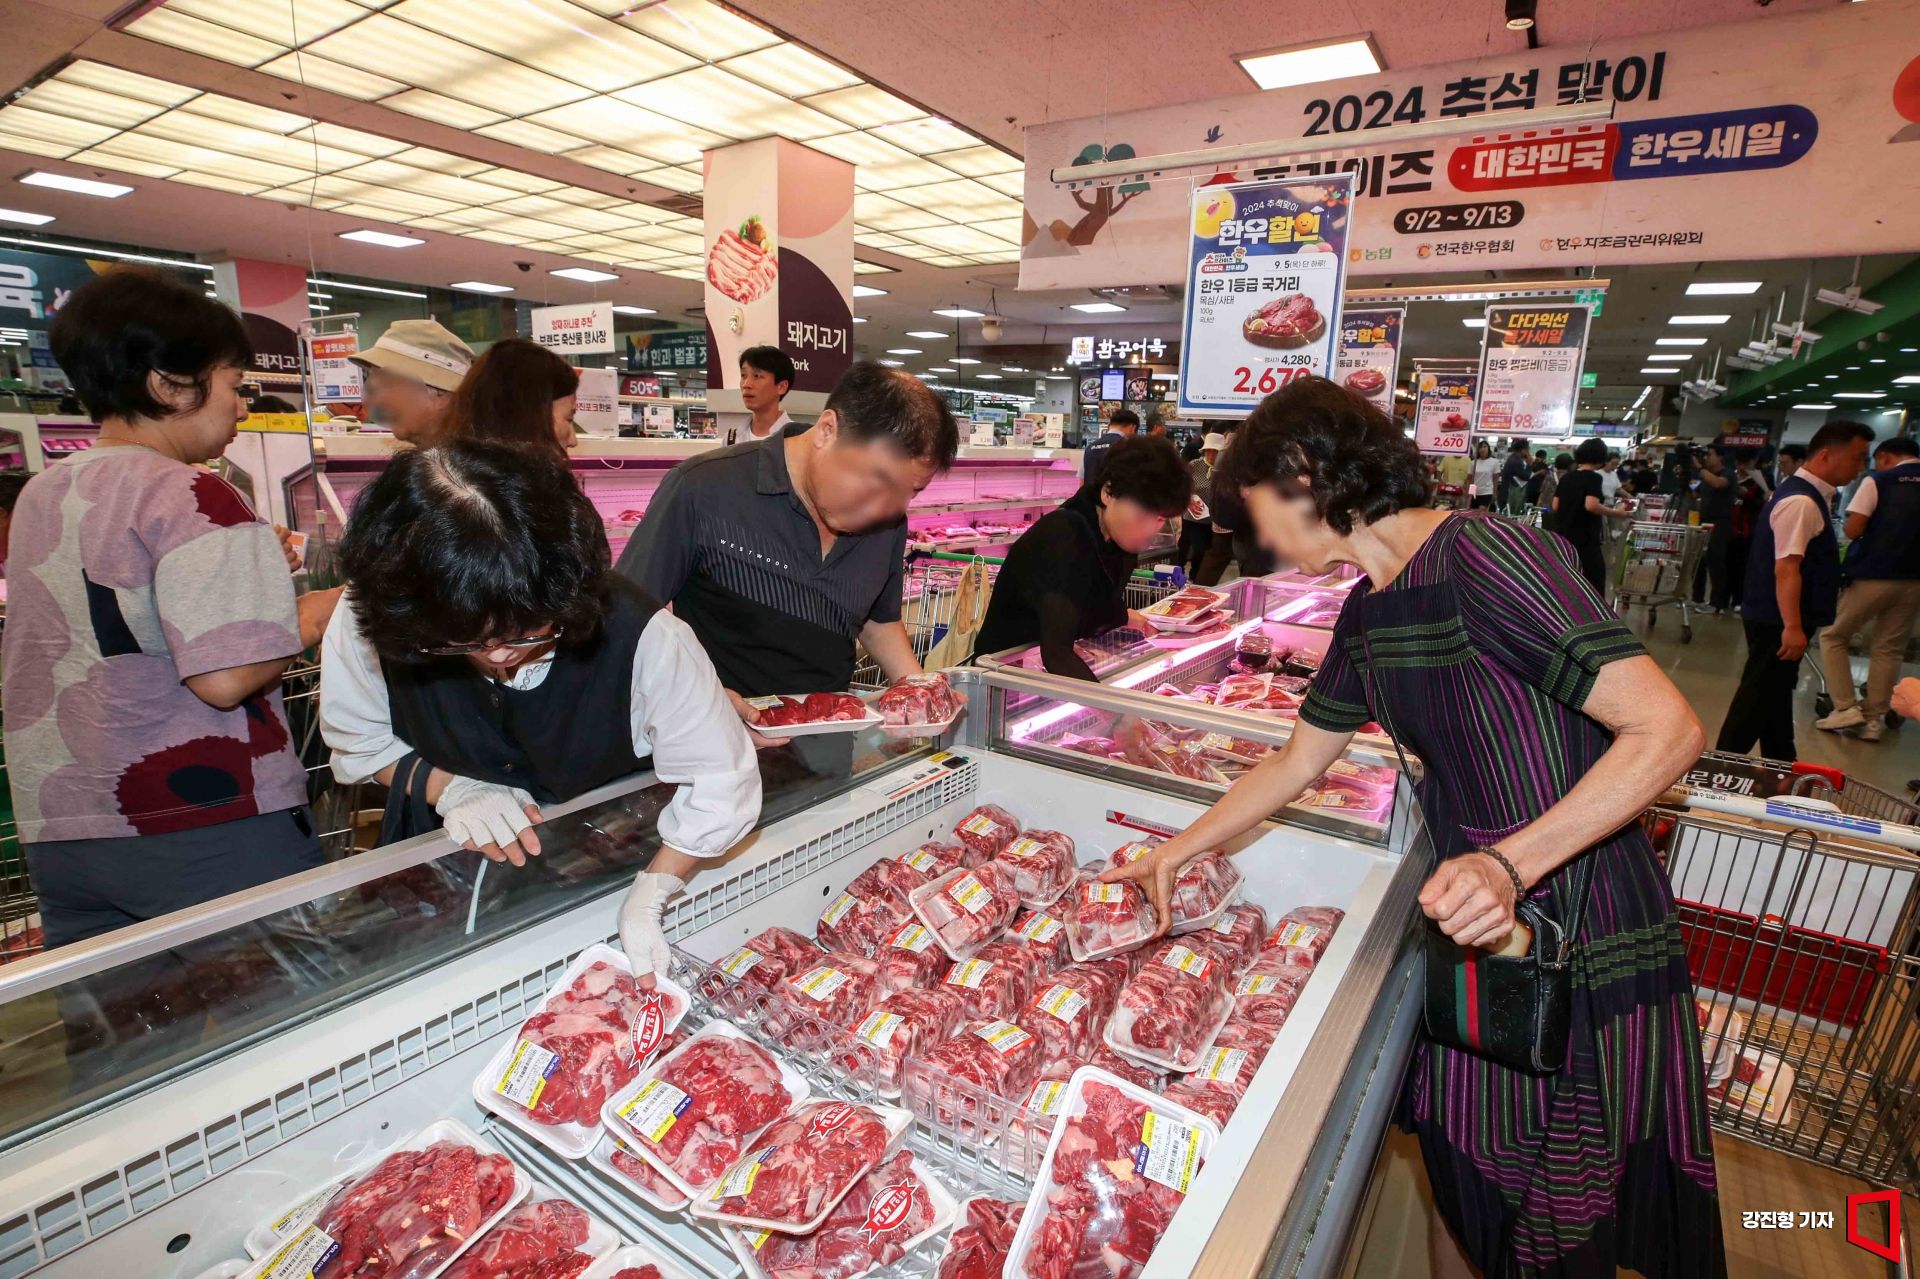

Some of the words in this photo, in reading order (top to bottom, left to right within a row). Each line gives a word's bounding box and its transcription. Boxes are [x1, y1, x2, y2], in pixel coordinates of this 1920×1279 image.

[1303, 86, 1426, 137] 2024
[1439, 68, 1539, 118] 추석
[1555, 52, 1666, 106] 맞이
[1472, 139, 1606, 180] 대한민국
[1628, 120, 1787, 168] 한우세일
[1242, 201, 1265, 217] 2024
[1266, 198, 1300, 213] 추석맞이
[1404, 210, 1442, 231] 9/2
[1463, 206, 1513, 228] 9/13
[1218, 214, 1321, 247] 한우할인
[1365, 247, 1392, 261] 농협
[1435, 239, 1515, 256] 전국한우협회
[1556, 231, 1704, 251] 한우자조금관리위원회
[1200, 279, 1225, 294] 한우
[1227, 277, 1259, 293] 1등급
[1261, 276, 1301, 293] 국거리
[1199, 294, 1235, 306] 목심/사태
[1199, 308, 1213, 316] 100g
[1507, 312, 1570, 329] 다다익선
[551, 318, 581, 330] 양재하나로
[580, 316, 594, 328] 추천
[539, 333, 560, 347] 브랜드
[560, 332, 584, 346] 축산물
[583, 330, 607, 345] 행사장
[787, 320, 848, 355] 돼지고기
[650, 347, 673, 367] 한과
[674, 346, 696, 366] 벌꿀
[1281, 354, 1312, 366] 4,280
[1488, 359, 1509, 371] 한우
[1433, 436, 1464, 448] 2,670
[720, 538, 789, 570] WESTWOOD
[1711, 772, 1755, 796] 한개.
